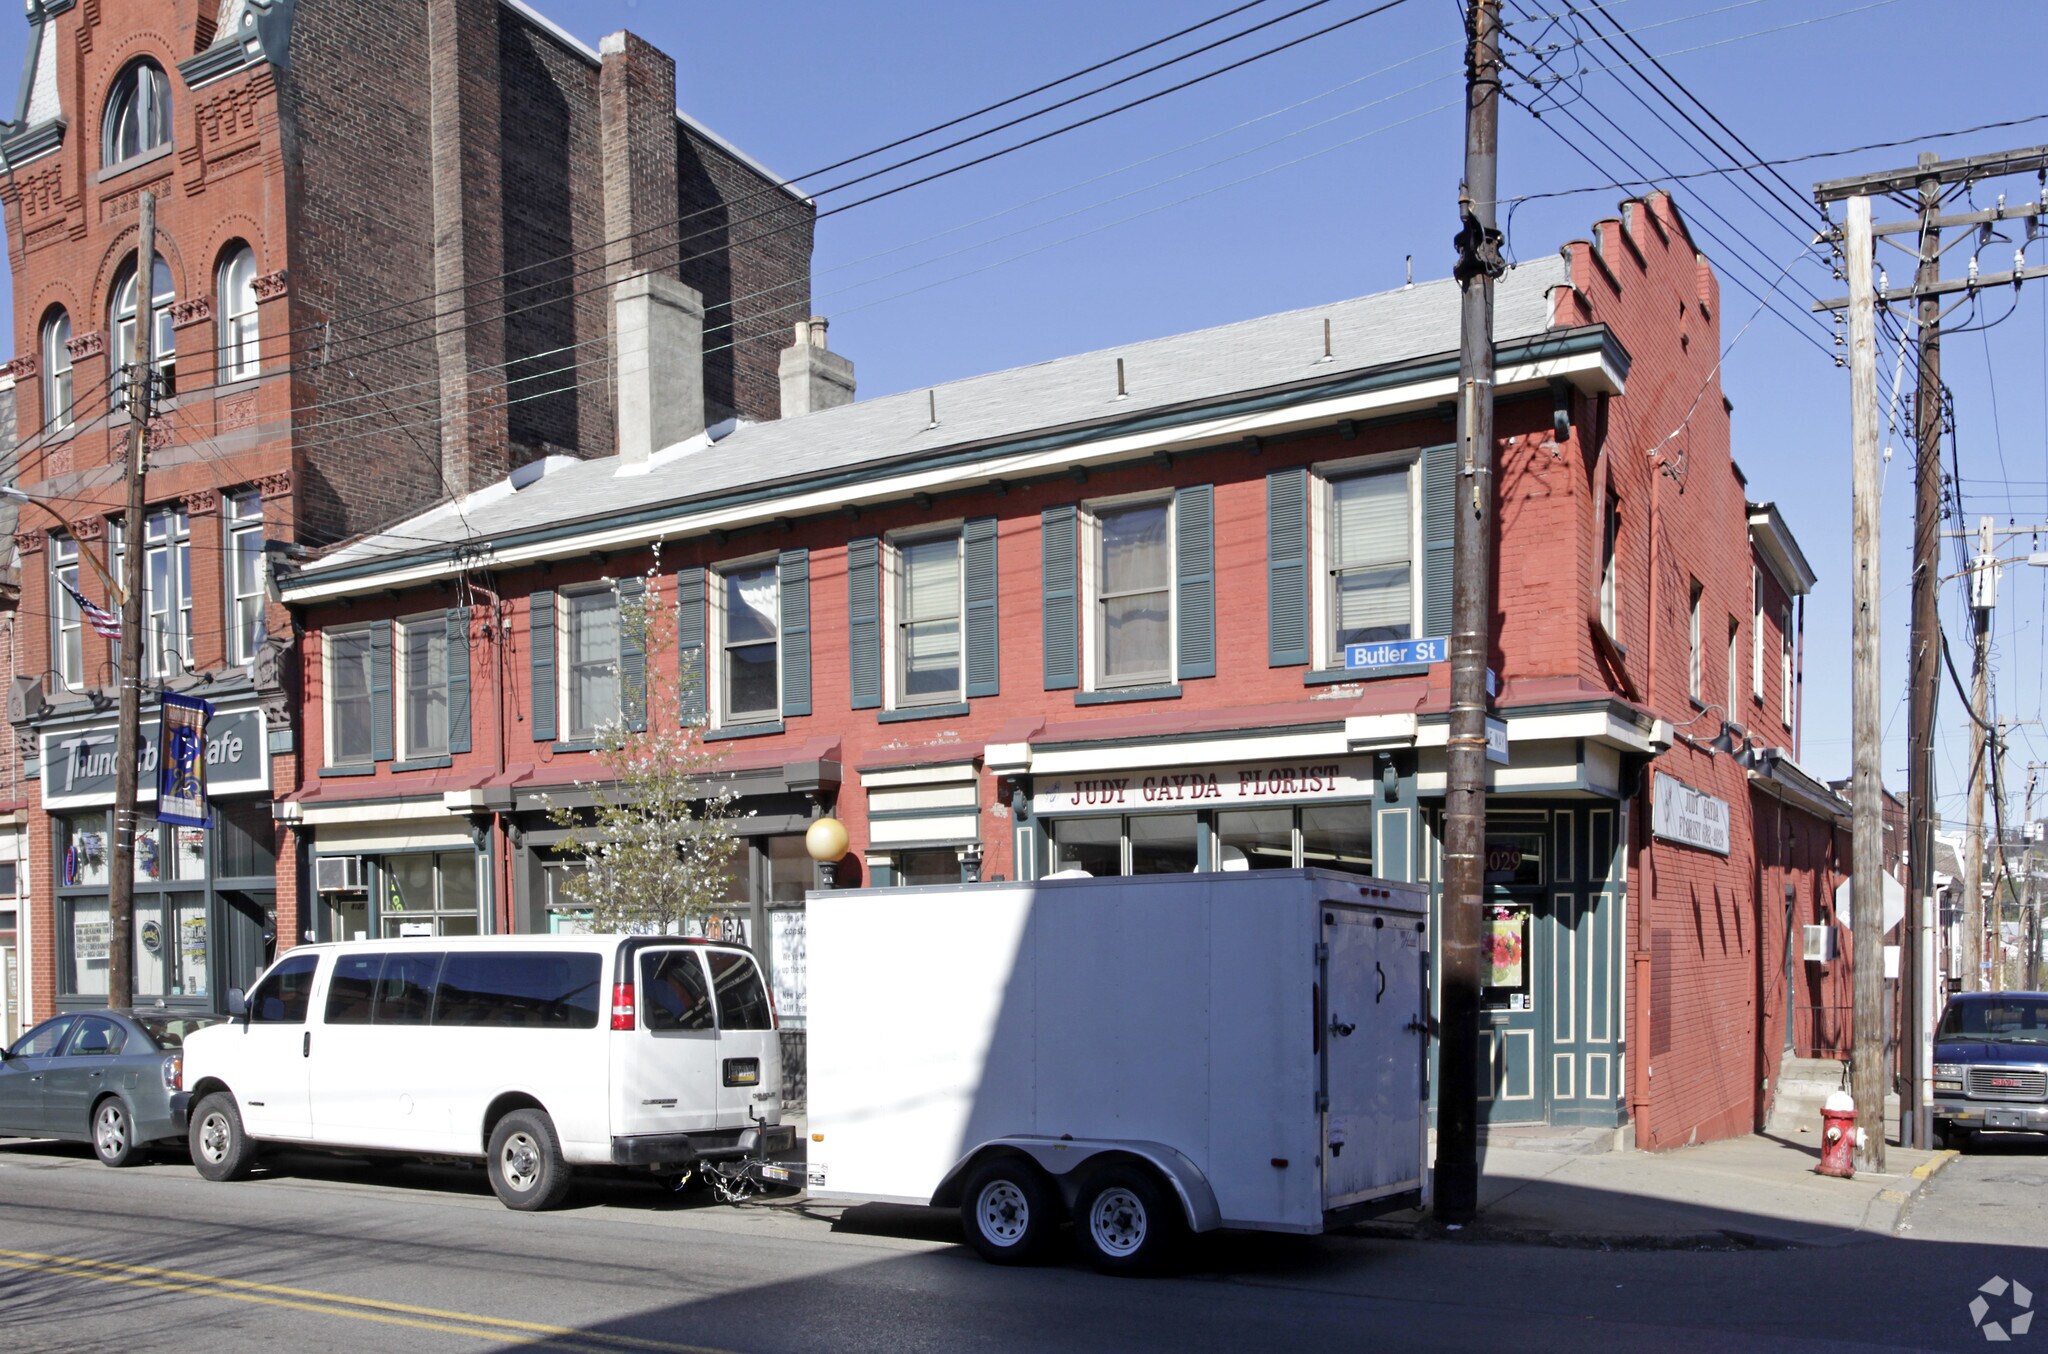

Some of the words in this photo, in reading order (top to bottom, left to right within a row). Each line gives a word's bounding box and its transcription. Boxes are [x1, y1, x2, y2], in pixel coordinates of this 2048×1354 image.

[1355, 646, 1408, 666] Butler
[1415, 642, 1436, 660] St
[206, 730, 243, 765] afe
[1071, 777, 1130, 806] JUDY
[1143, 771, 1222, 802] GAYDA
[1238, 764, 1340, 797] FLORIST
[1685, 792, 1699, 816] JUDY
[1703, 800, 1719, 822] GAYDA
[1679, 815, 1702, 842] FLORIST
[1487, 851, 1521, 871] 029
[698, 915, 748, 945] YOGA
